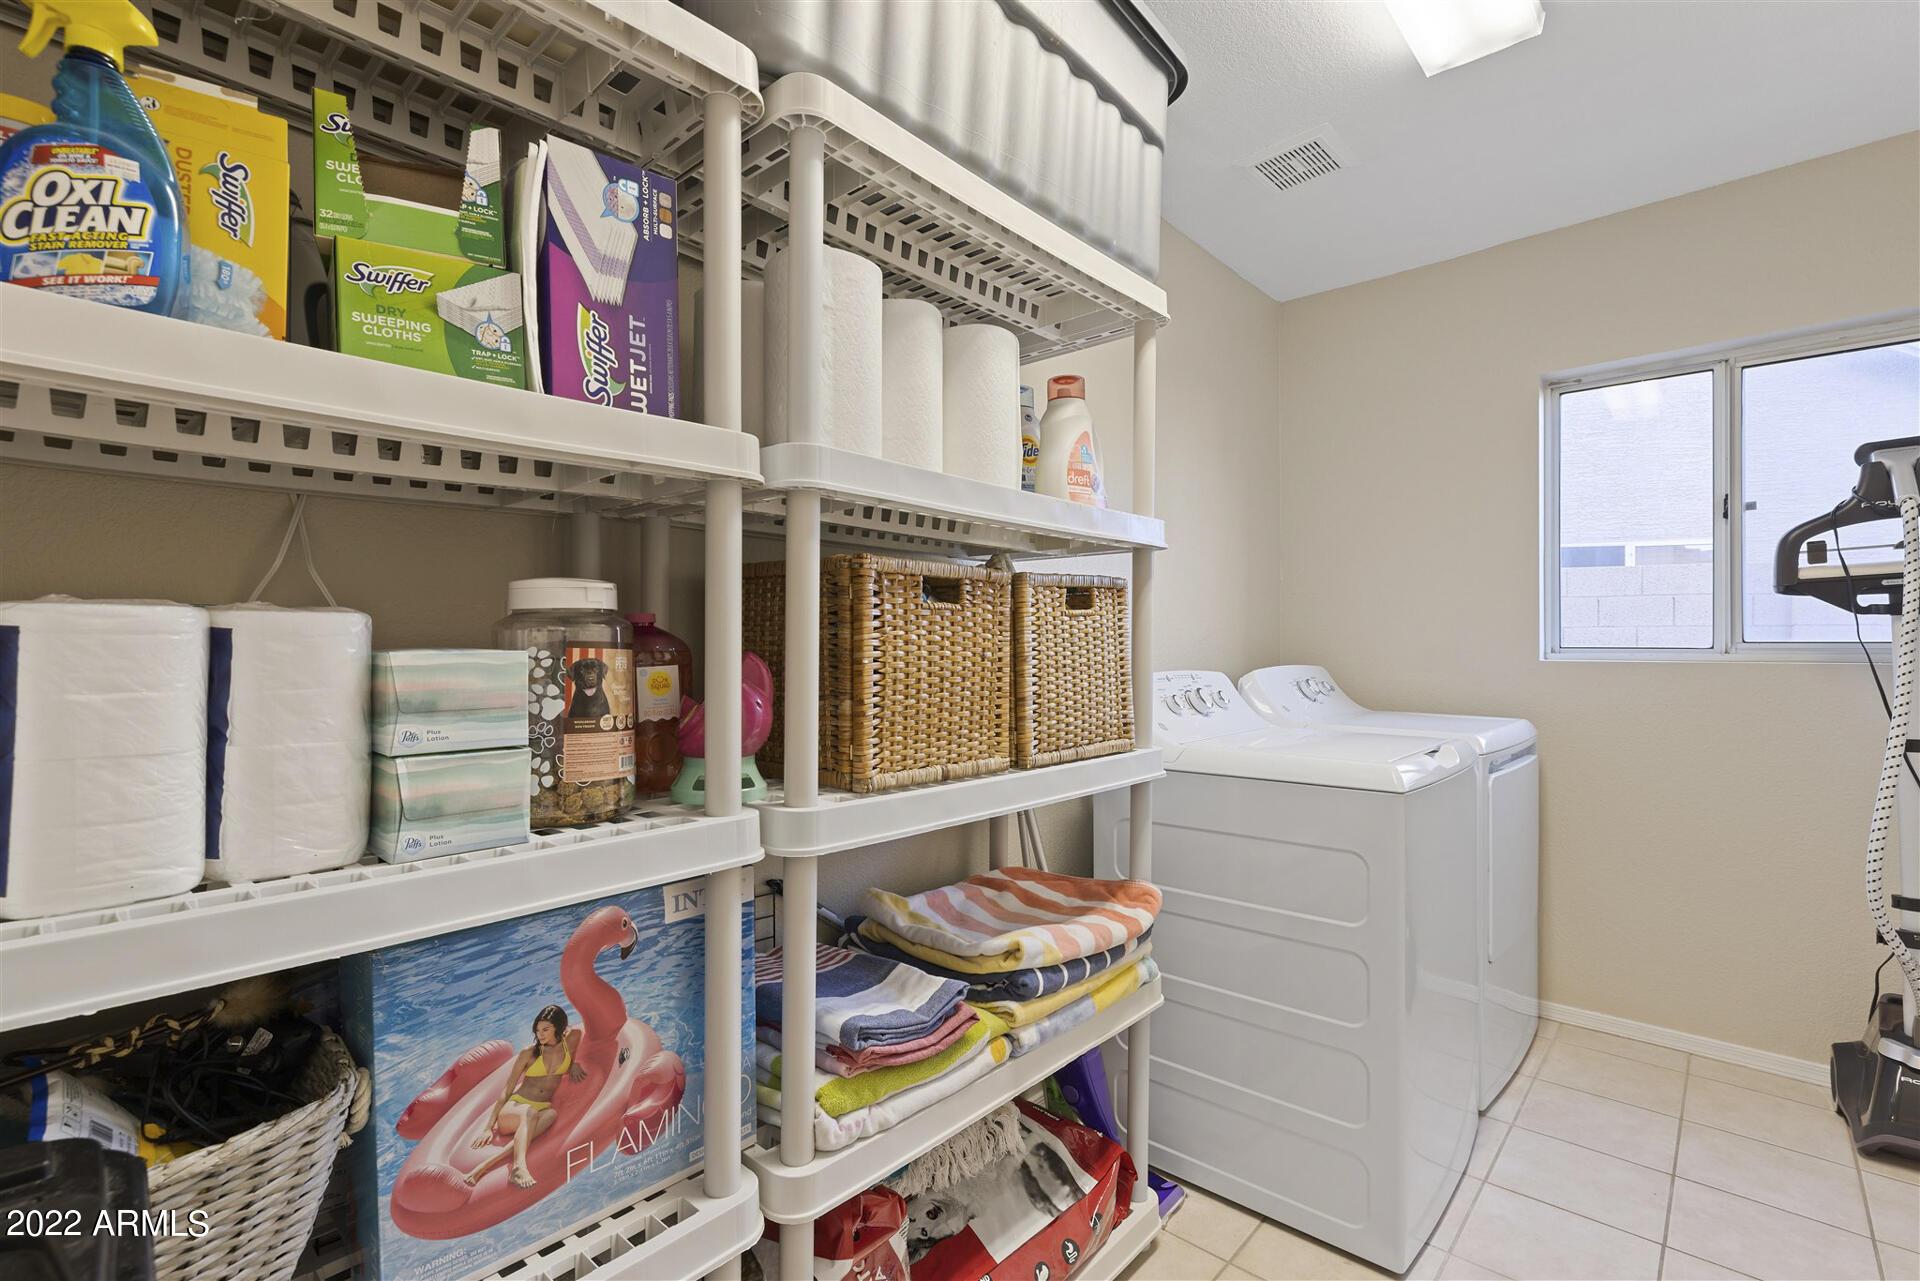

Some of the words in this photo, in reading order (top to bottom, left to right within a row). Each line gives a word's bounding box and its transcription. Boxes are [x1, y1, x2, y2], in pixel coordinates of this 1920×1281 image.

[30, 171, 118, 207] OXI
[210, 152, 250, 240] Swiffer
[2, 204, 148, 241] CLEAN
[642, 206, 650, 242] ABSORB
[29, 240, 66, 251] STAIN
[68, 240, 129, 250] REMOVER
[41, 276, 66, 286] SEE
[67, 275, 82, 284] IT
[344, 261, 432, 294] Swiffer
[375, 303, 407, 317] DRY
[351, 311, 432, 333] SWEEPING
[362, 324, 422, 343] CLOTHS
[471, 349, 492, 357] TRAP
[583, 310, 617, 407] Swiffer
[1067, 471, 1090, 487] dreft
[401, 730, 420, 743] Puffs
[404, 837, 422, 850] Puffs
